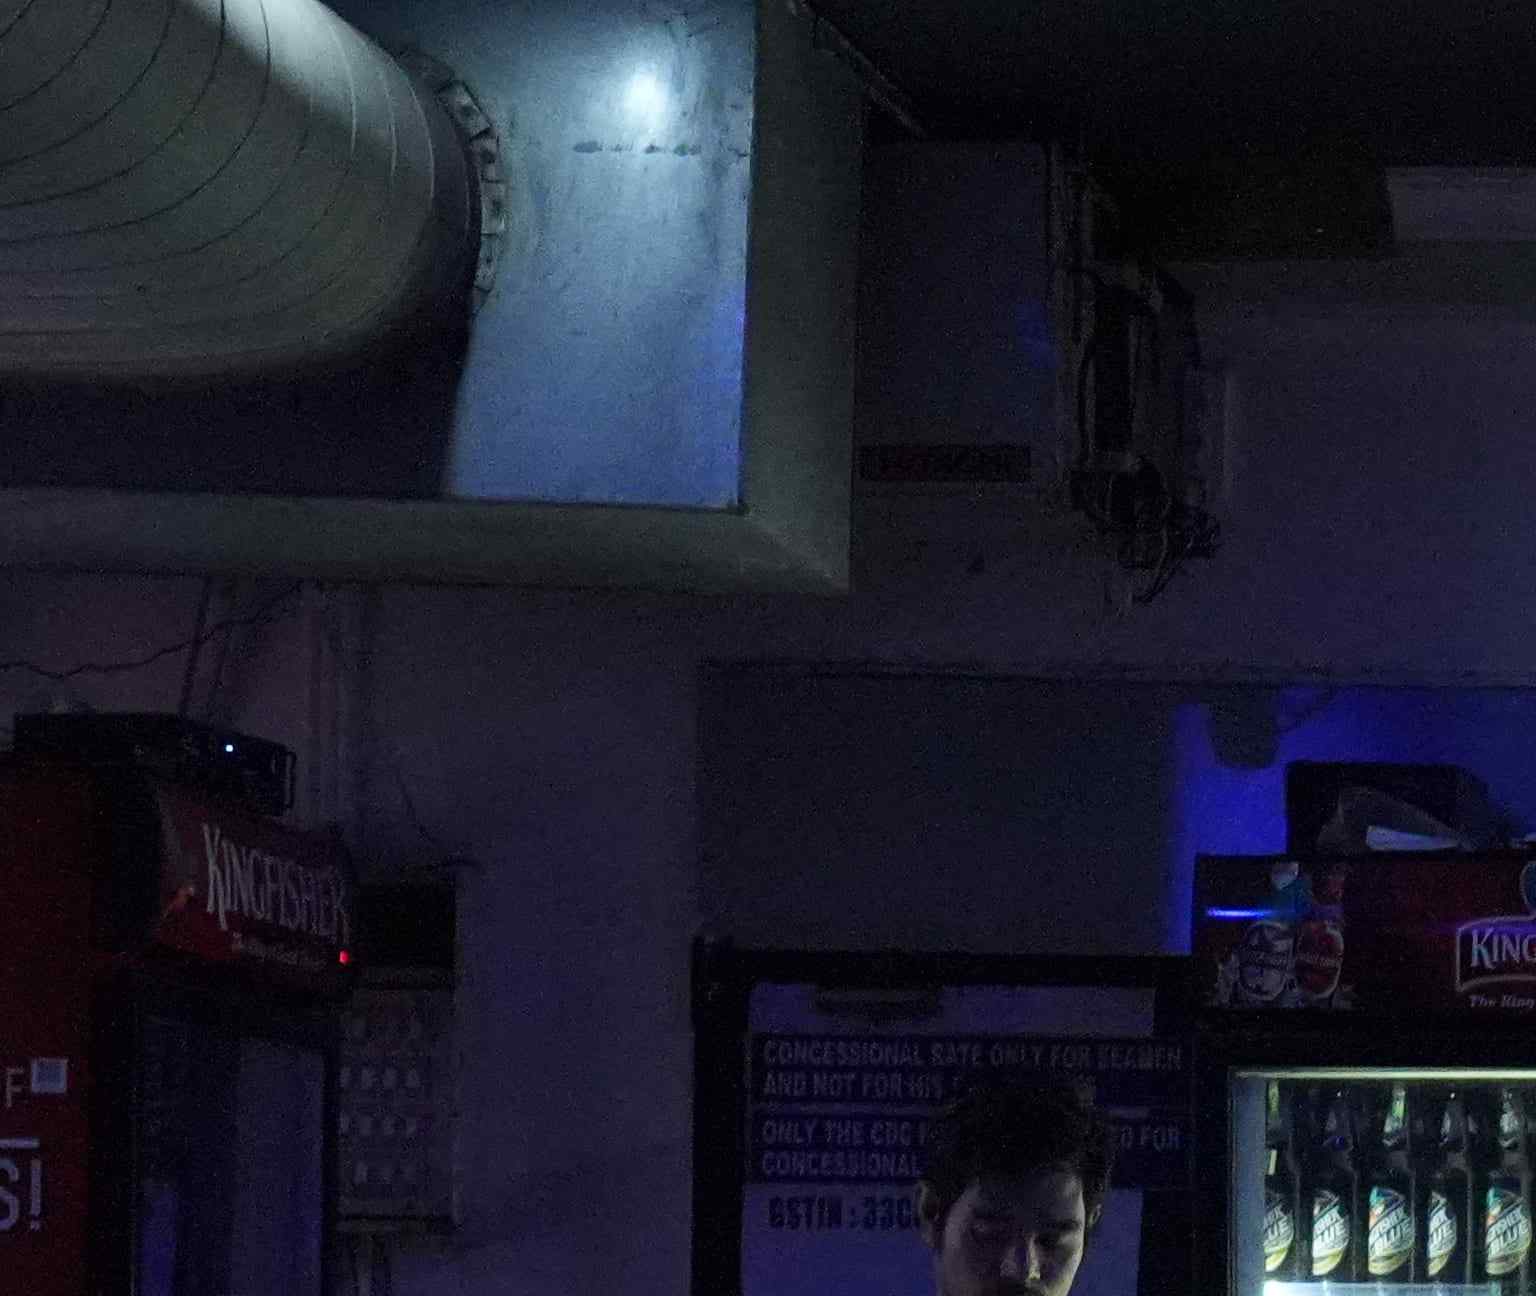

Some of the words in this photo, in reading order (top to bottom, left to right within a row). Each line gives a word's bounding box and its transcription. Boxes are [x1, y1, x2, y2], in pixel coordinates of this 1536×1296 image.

[1500, 994, 1535, 1009] King
[763, 1040, 924, 1066] CONCESSIONAL
[1050, 1043, 1091, 1069] FOR
[763, 1072, 807, 1097] AND
[813, 1072, 857, 1097] NOT
[861, 1072, 904, 1098] FOR
[762, 1120, 817, 1144] ONLY
[824, 1120, 866, 1145] THE
[762, 1151, 923, 1176] CONCESSIONAL
